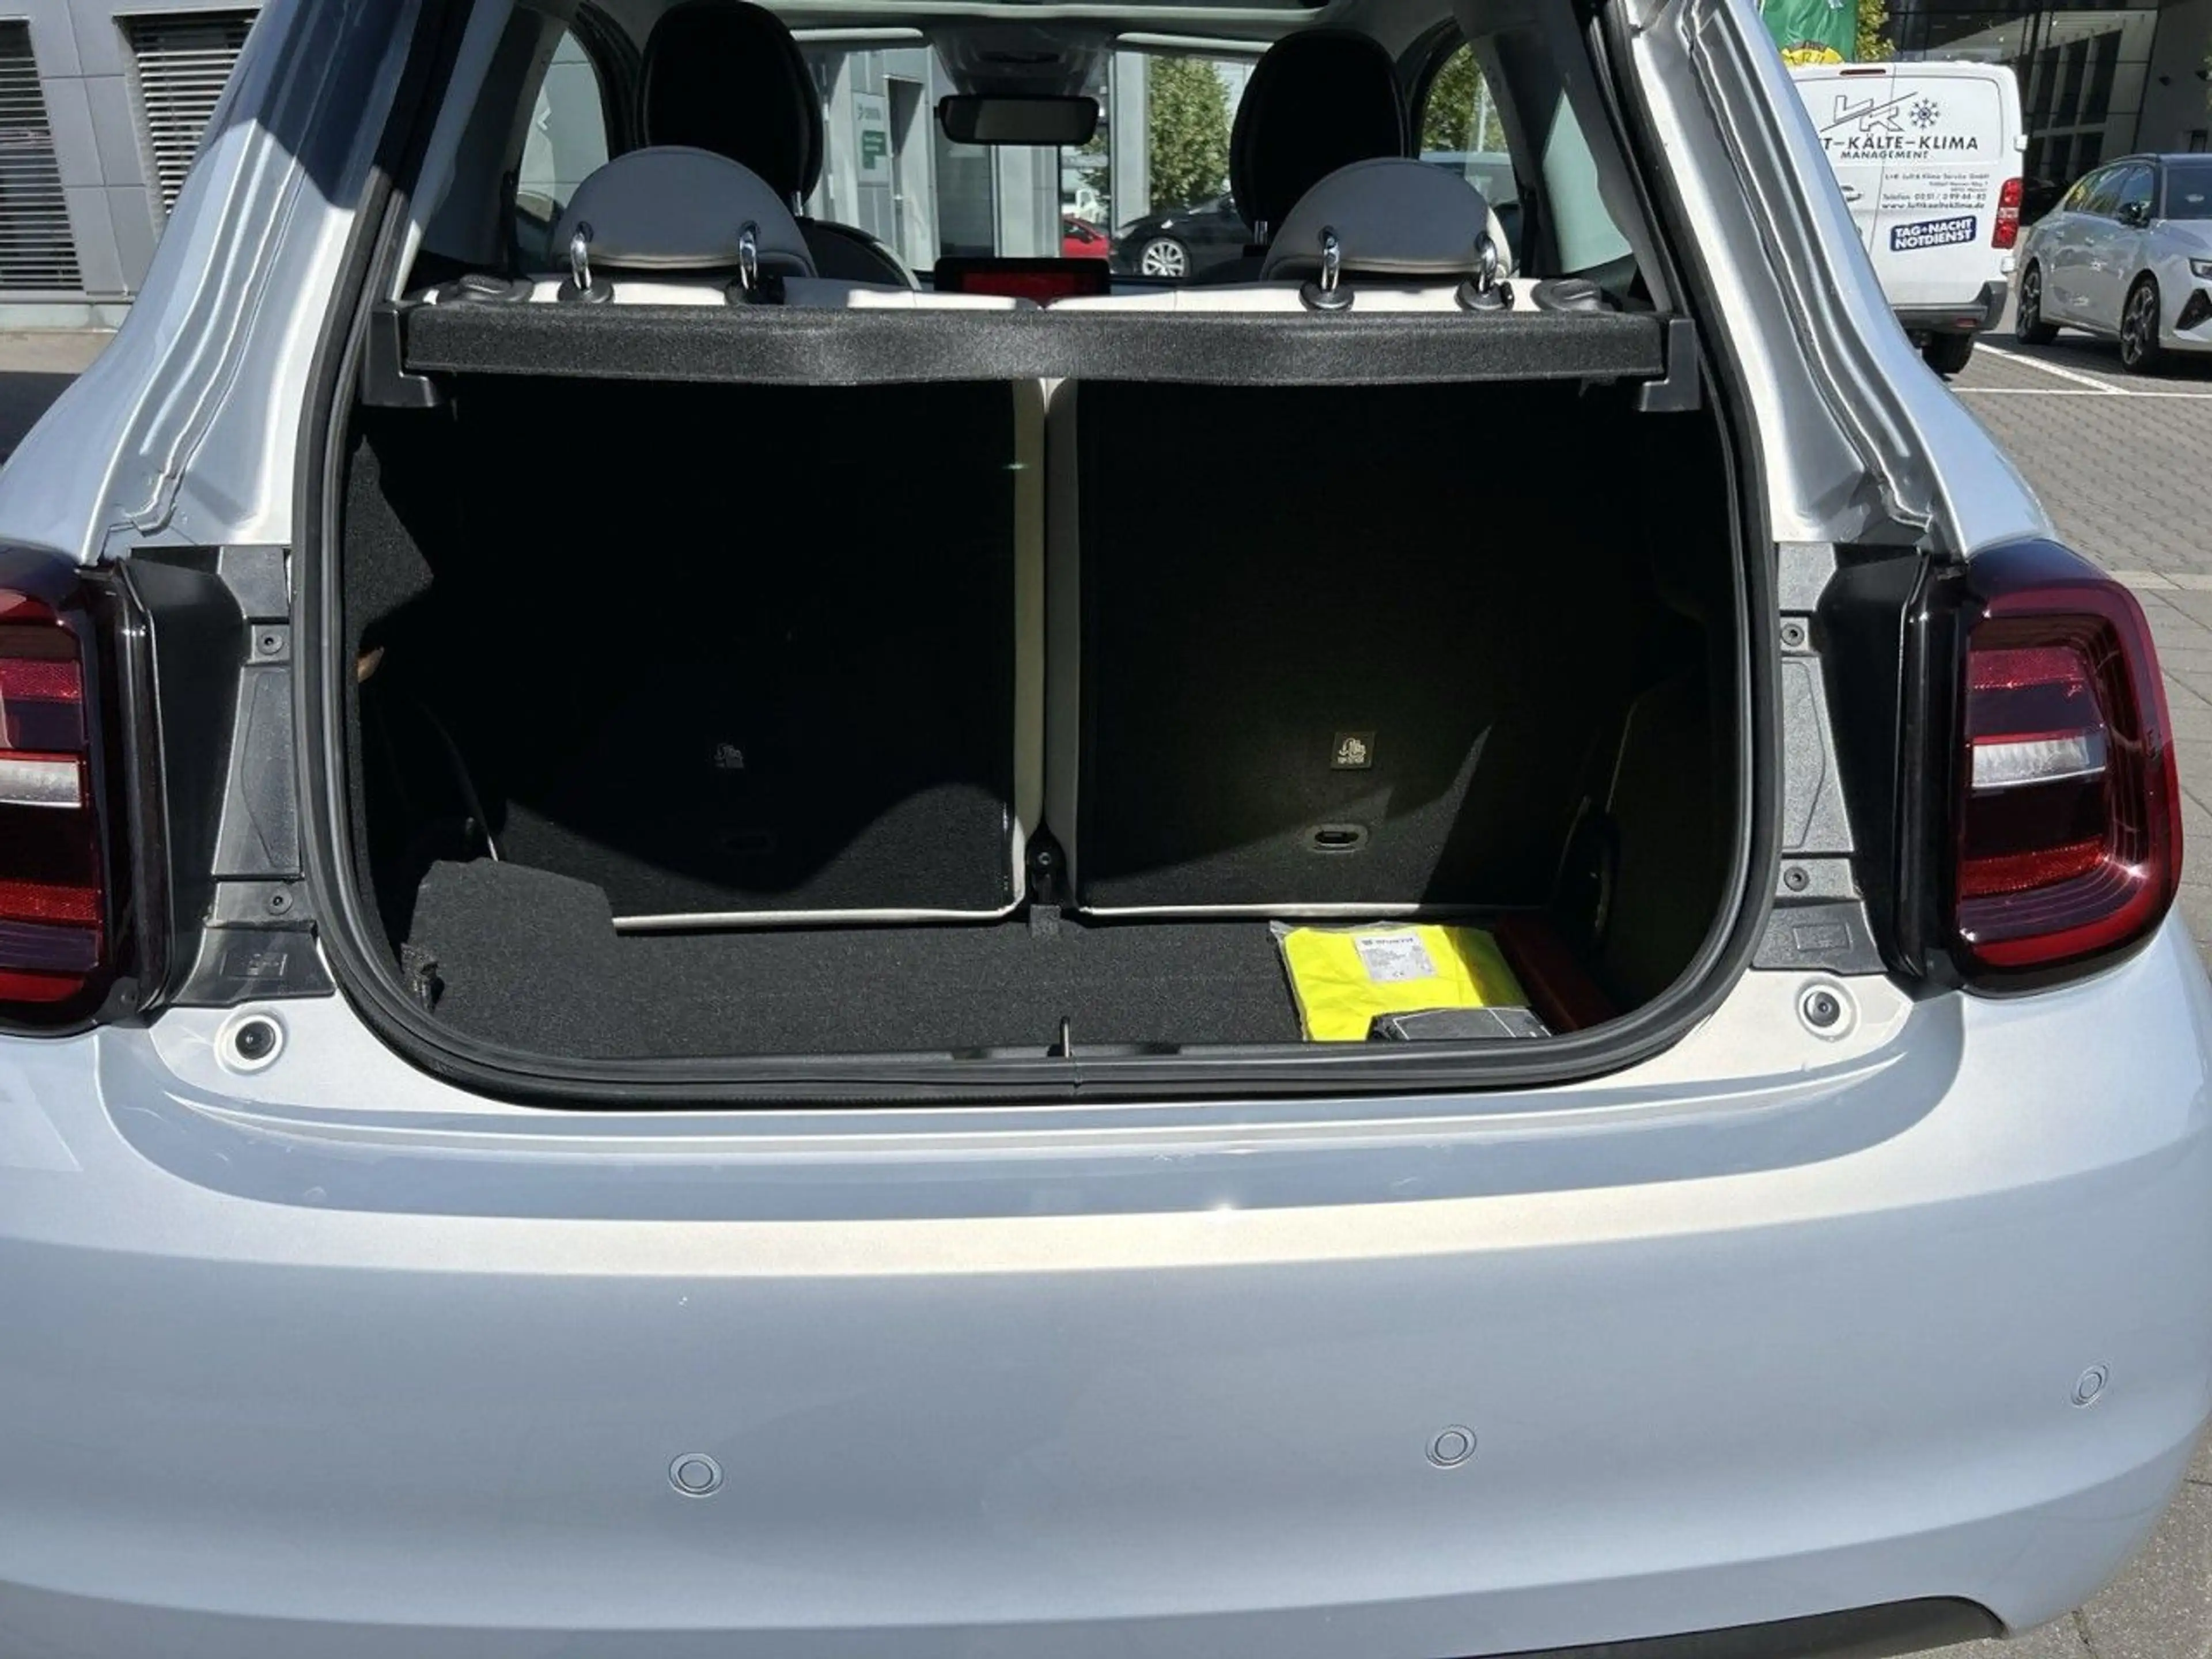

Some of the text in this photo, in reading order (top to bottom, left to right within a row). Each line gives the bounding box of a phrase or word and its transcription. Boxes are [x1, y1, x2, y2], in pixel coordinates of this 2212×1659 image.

[1819, 133, 1978, 150] T-KÄLTE-KLIMA
[1840, 150, 1929, 160] MANAGEMENT
[1895, 229, 1972, 249] NOTDIENST
